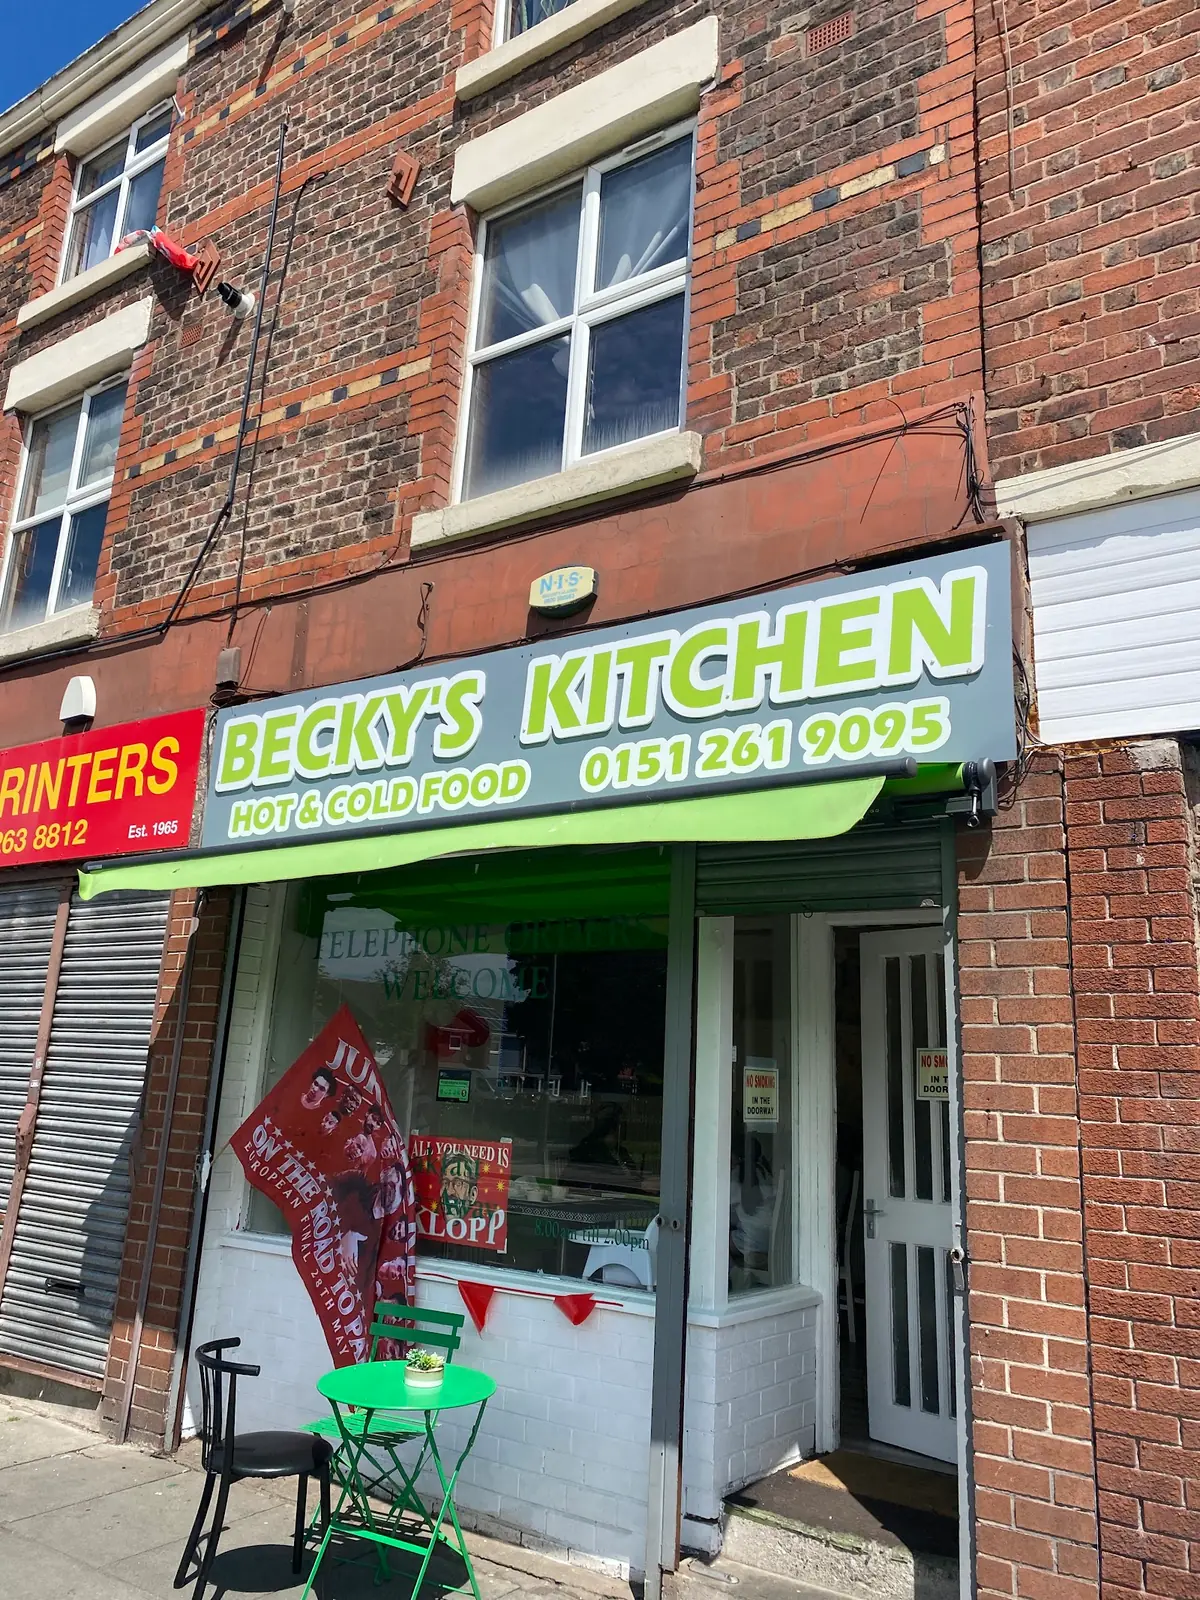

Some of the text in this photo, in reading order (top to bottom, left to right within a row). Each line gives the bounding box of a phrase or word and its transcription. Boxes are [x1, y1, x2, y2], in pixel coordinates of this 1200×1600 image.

[217, 570, 983, 790] BECKY'S KITCHEN
[582, 700, 947, 791] 0151 261 9095
[231, 762, 529, 836] HOT & COLD FOOD
[0, 819, 88, 854] 63 8812
[128, 819, 179, 838] Est. 1965
[313, 922, 491, 960] TELEPHONE
[382, 966, 550, 1001] WELCOME
[921, 1055, 932, 1068] NO
[746, 1074, 776, 1089] NO SMOKING
[747, 1107, 775, 1115] DOORWAY
[752, 1097, 771, 1105] IN THE
[410, 1140, 509, 1168] ALL YOU NEED IS
[252, 1124, 284, 1163] ON
[277, 1153, 322, 1204] THE
[309, 1198, 337, 1275] ROAD
[330, 1271, 356, 1316] TO
[416, 1204, 505, 1245] KLOPP
[535, 1218, 650, 1252] 8.00am till 2.00pm
[243, 1141, 350, 1356] EUROPEAN FINAL 28TH MAY
